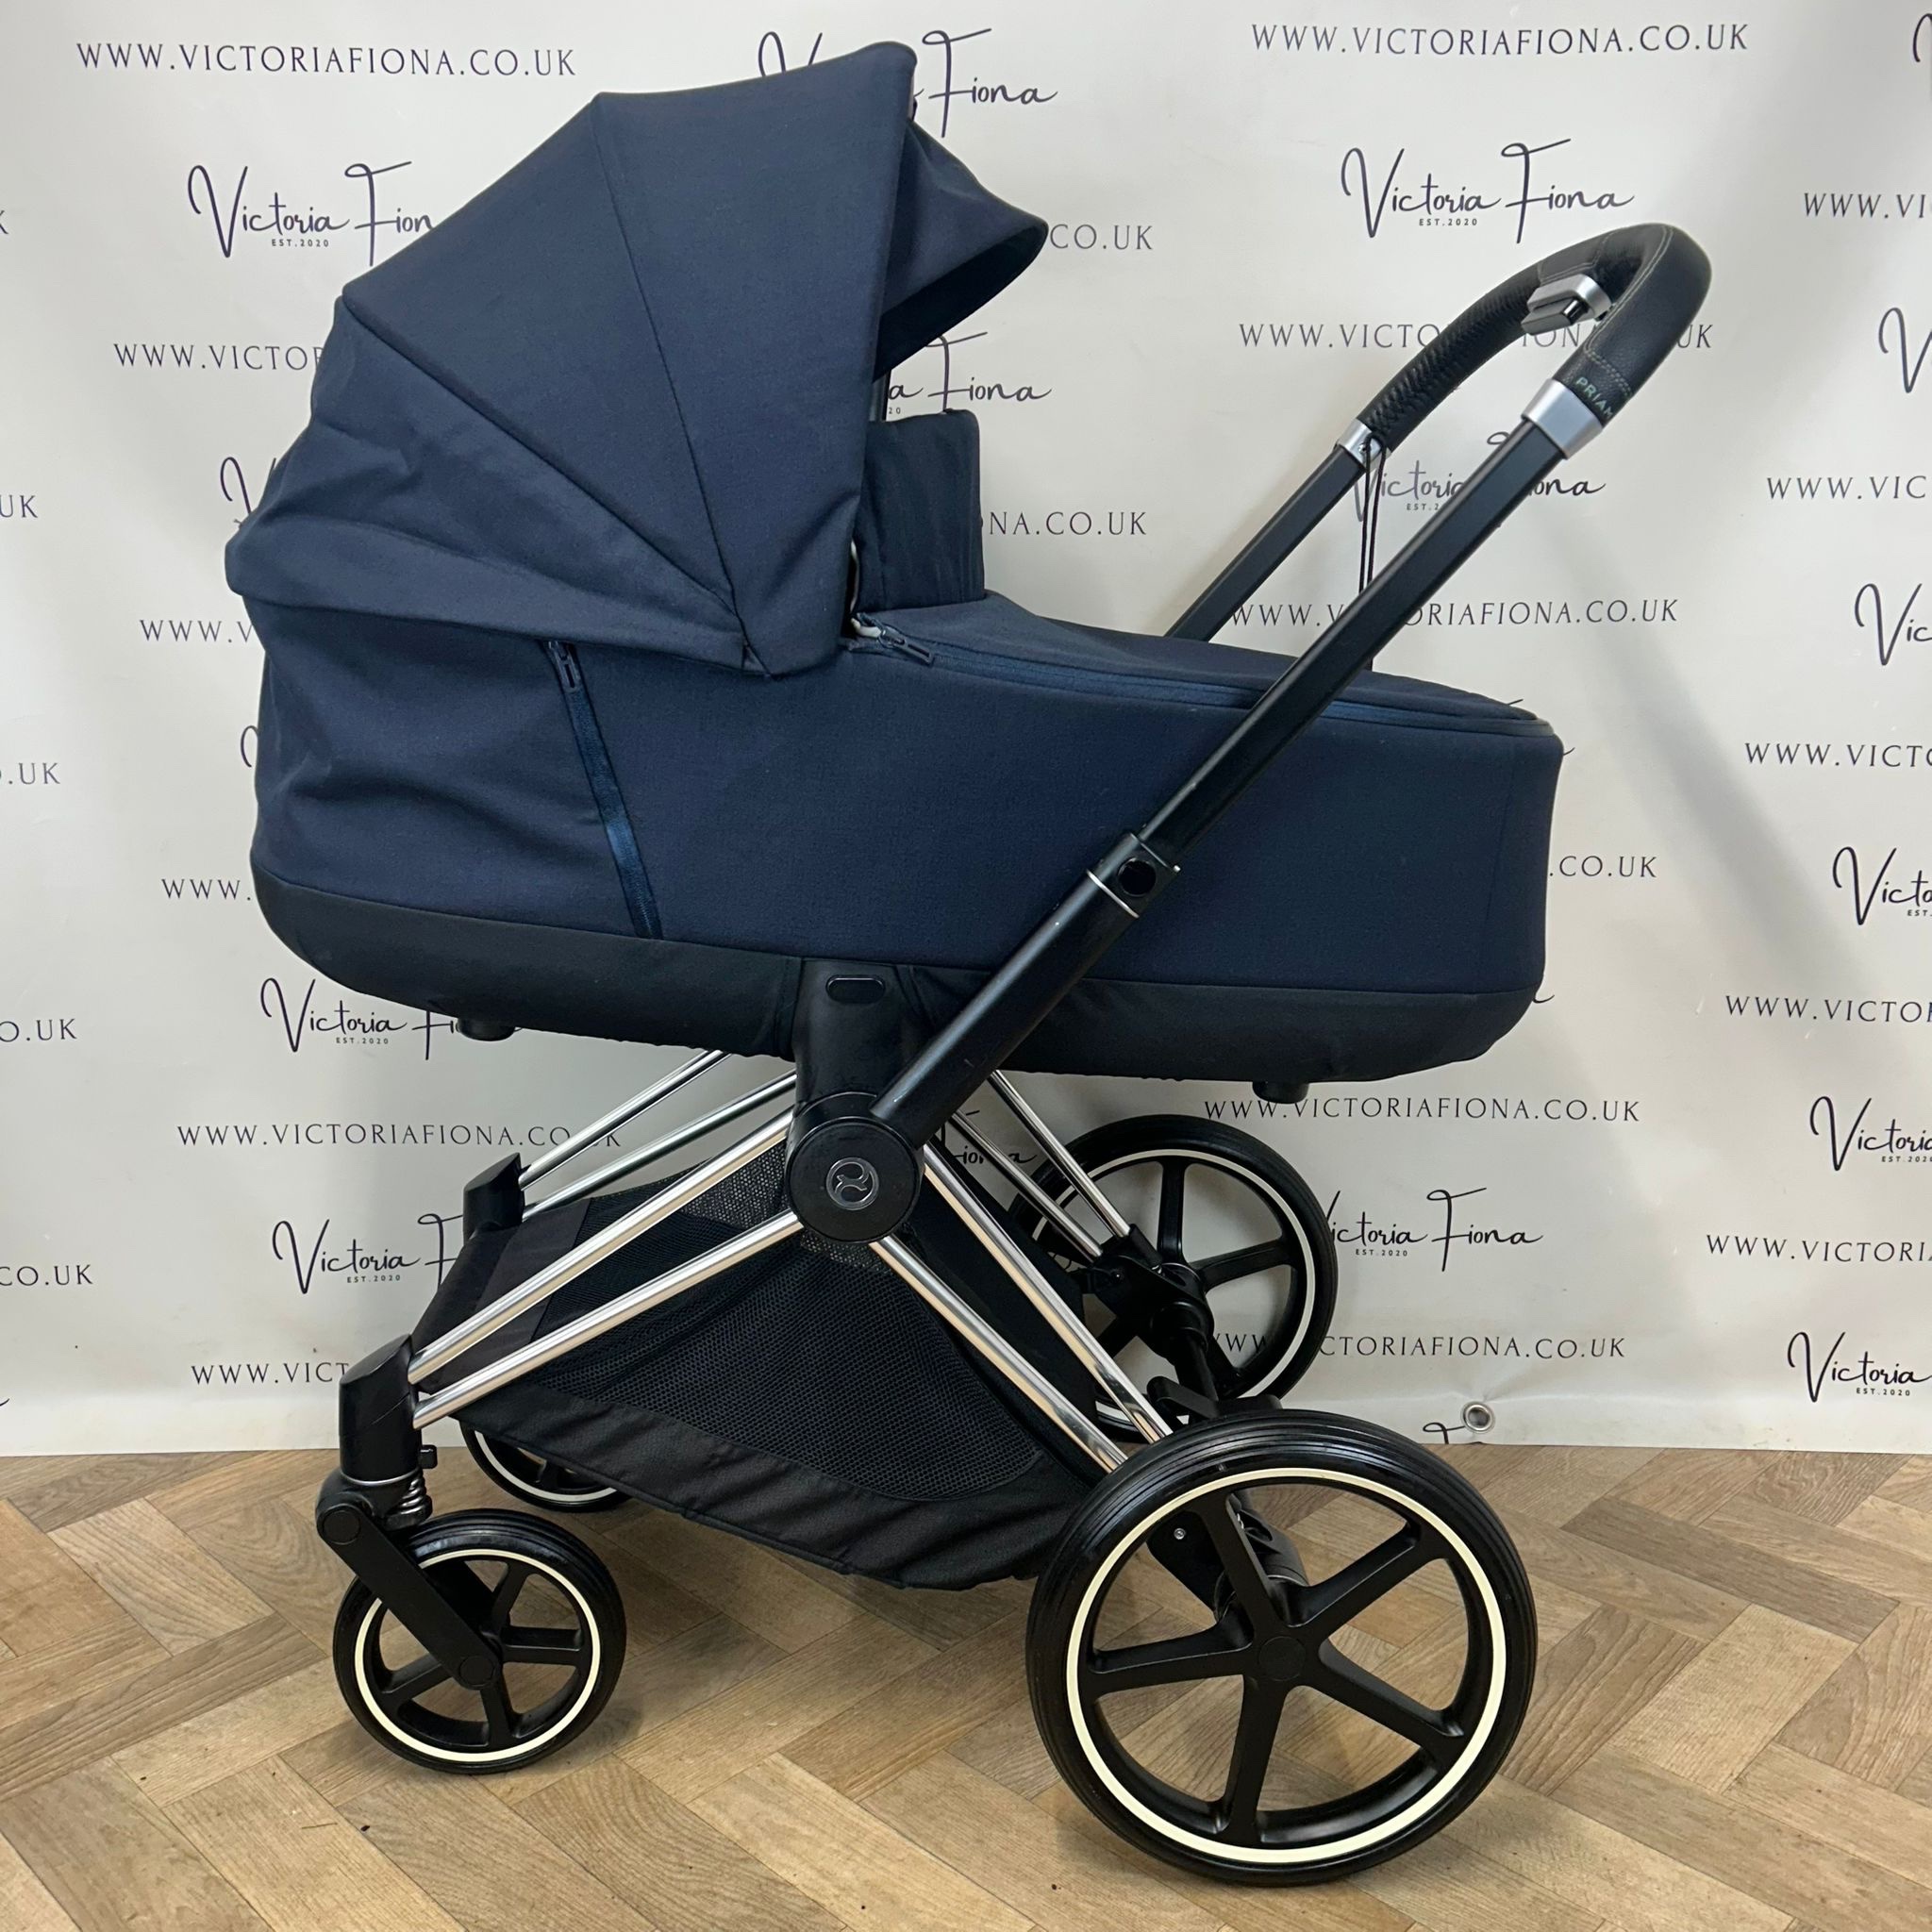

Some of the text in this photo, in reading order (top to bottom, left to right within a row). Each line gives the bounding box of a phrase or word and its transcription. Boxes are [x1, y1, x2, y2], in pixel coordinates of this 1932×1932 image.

[1252, 23, 1749, 57] WWW.VICTORIAFIONA.CO.UK
[77, 42, 576, 77] WWW.VICTORIAFIONA.CO.UK
[922, 27, 1058, 139] Fiona
[1341, 138, 1635, 243] Victoria Fiona
[188, 164, 350, 258] Victoria
[1418, 218, 1478, 227] EST.2020
[271, 239, 330, 247] EST.2020
[1576, 377, 1614, 418] PRIAM
[981, 510, 1147, 536] NA.CO.UK
[1744, 742, 1932, 768] WWW.VICT
[260, 977, 408, 1053] Victoria
[1725, 995, 1932, 1023] WWW.VICTO
[1204, 1096, 1641, 1124] WWW.VICTORIAFIONA.CO.UK
[1425, 1188, 1544, 1272] Fiona
[272, 1219, 421, 1294] Victoria
[1355, 1248, 1408, 1257] EST.2020
[346, 1274, 402, 1284] EST.2020
[1787, 1331, 1932, 1403] Victoria
[1856, 1387, 1911, 1396] EST.2020
